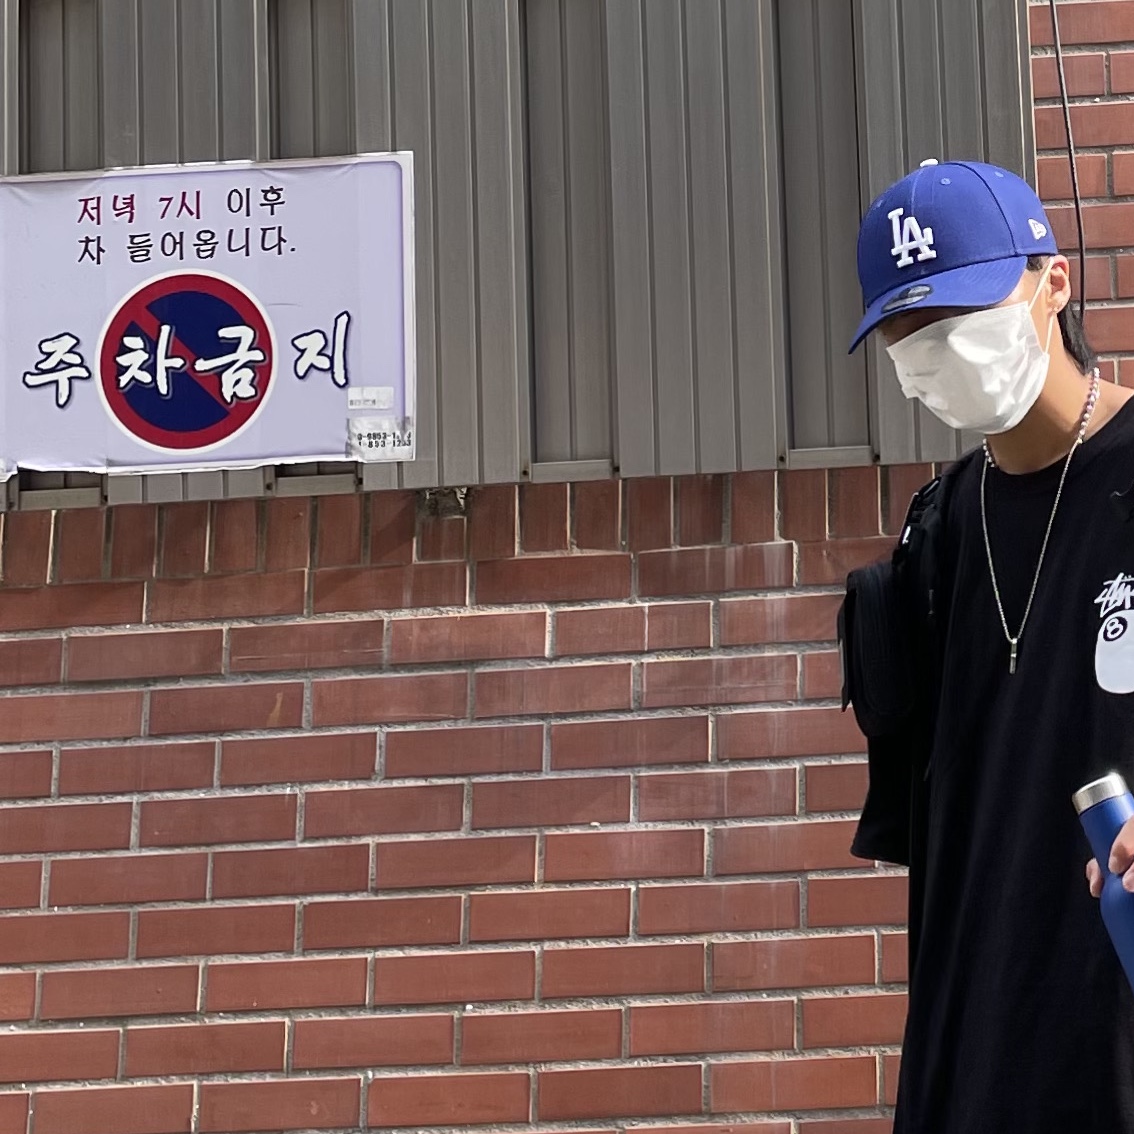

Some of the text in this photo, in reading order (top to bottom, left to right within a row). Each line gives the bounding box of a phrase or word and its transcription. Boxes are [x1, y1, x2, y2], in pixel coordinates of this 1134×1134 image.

[77, 186, 287, 226] 저녁 7시 이후
[77, 225, 297, 265] 차 들어옵니다.
[887, 207, 937, 269] LA
[1106, 617, 1124, 640] 8
